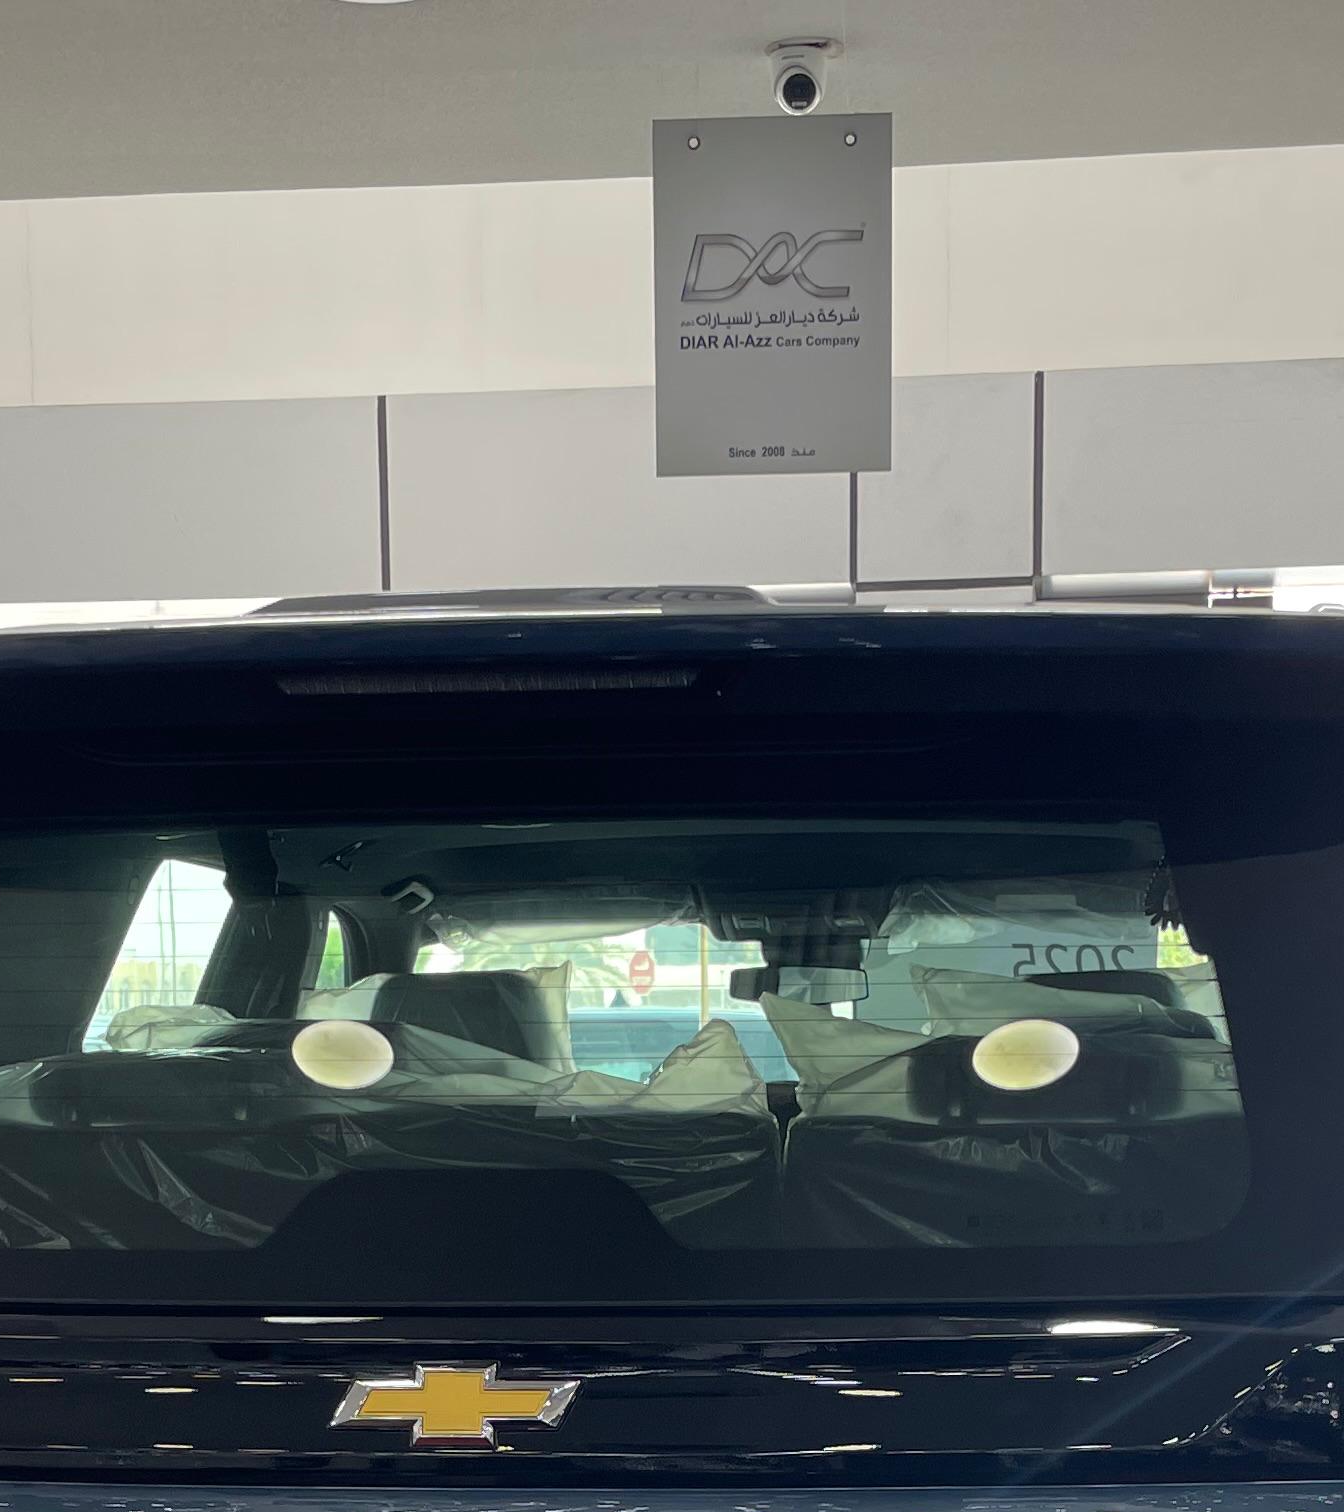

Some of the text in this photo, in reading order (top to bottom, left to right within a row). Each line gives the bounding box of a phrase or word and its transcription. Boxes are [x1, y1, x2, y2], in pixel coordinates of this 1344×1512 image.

[695, 311, 753, 329] للسيارات
[816, 306, 860, 326] شركة
[680, 334, 860, 350] DIAR Al-Azz Cars Company
[728, 447, 756, 458] Since
